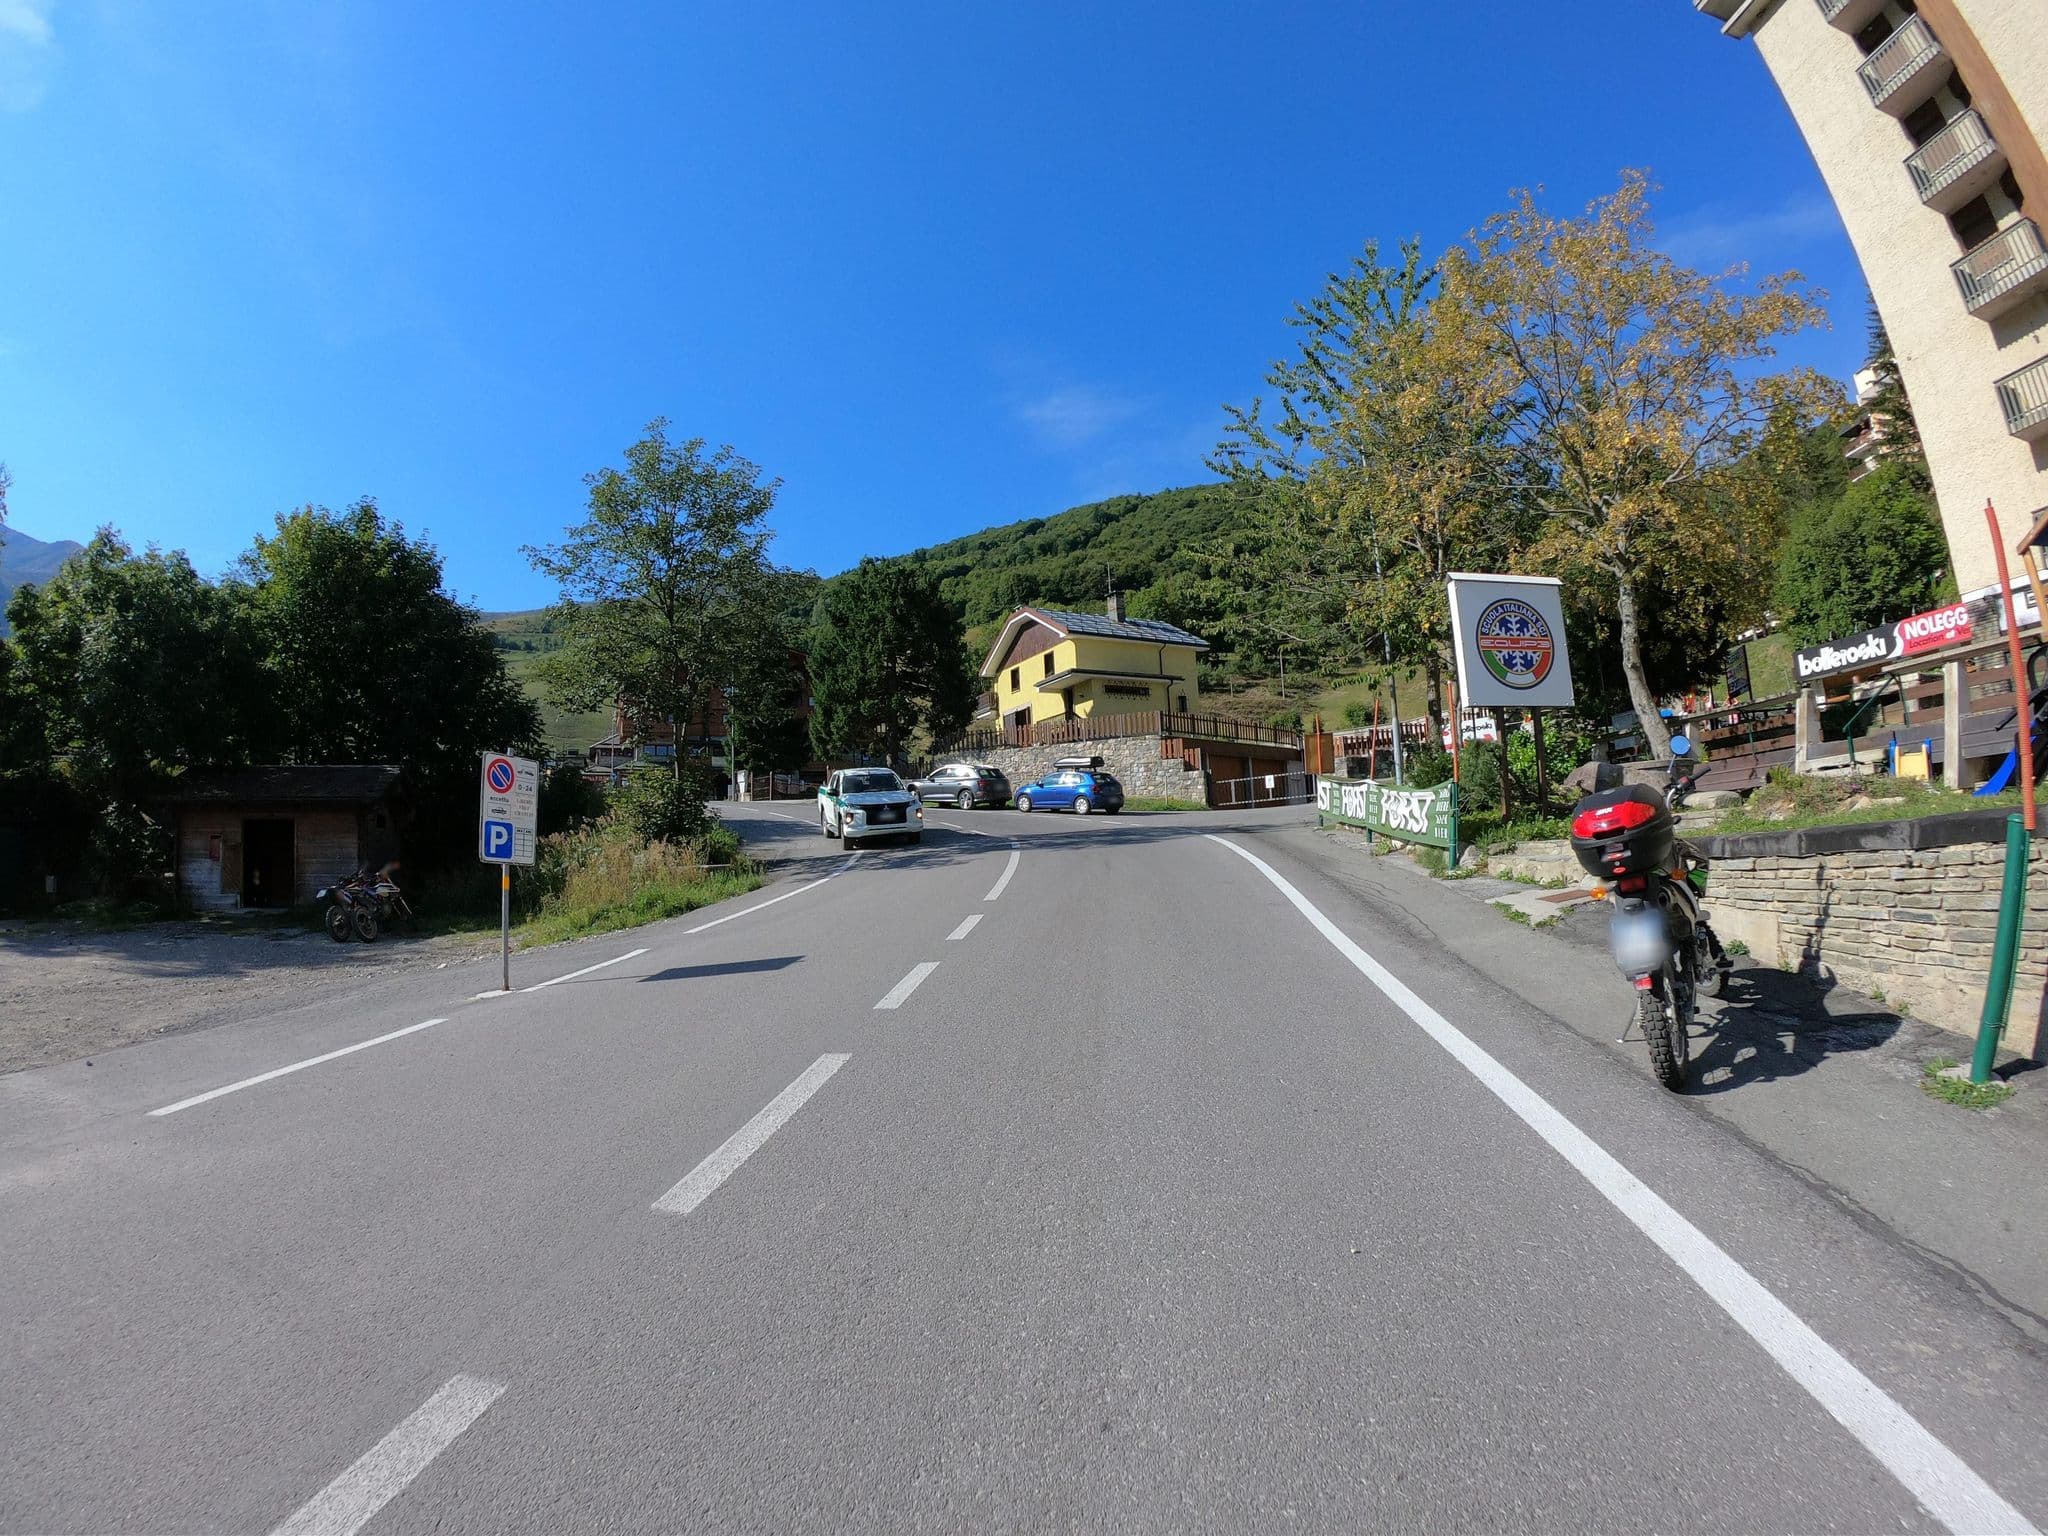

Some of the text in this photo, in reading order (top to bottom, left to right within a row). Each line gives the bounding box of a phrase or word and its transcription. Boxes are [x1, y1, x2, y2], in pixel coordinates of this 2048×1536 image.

[1482, 606, 1504, 633] SCUOLA
[1504, 603, 1537, 622] ITALIANA
[1341, 783, 1368, 821] FORST
[1381, 787, 1435, 834] FORST
[490, 825, 508, 854] P
